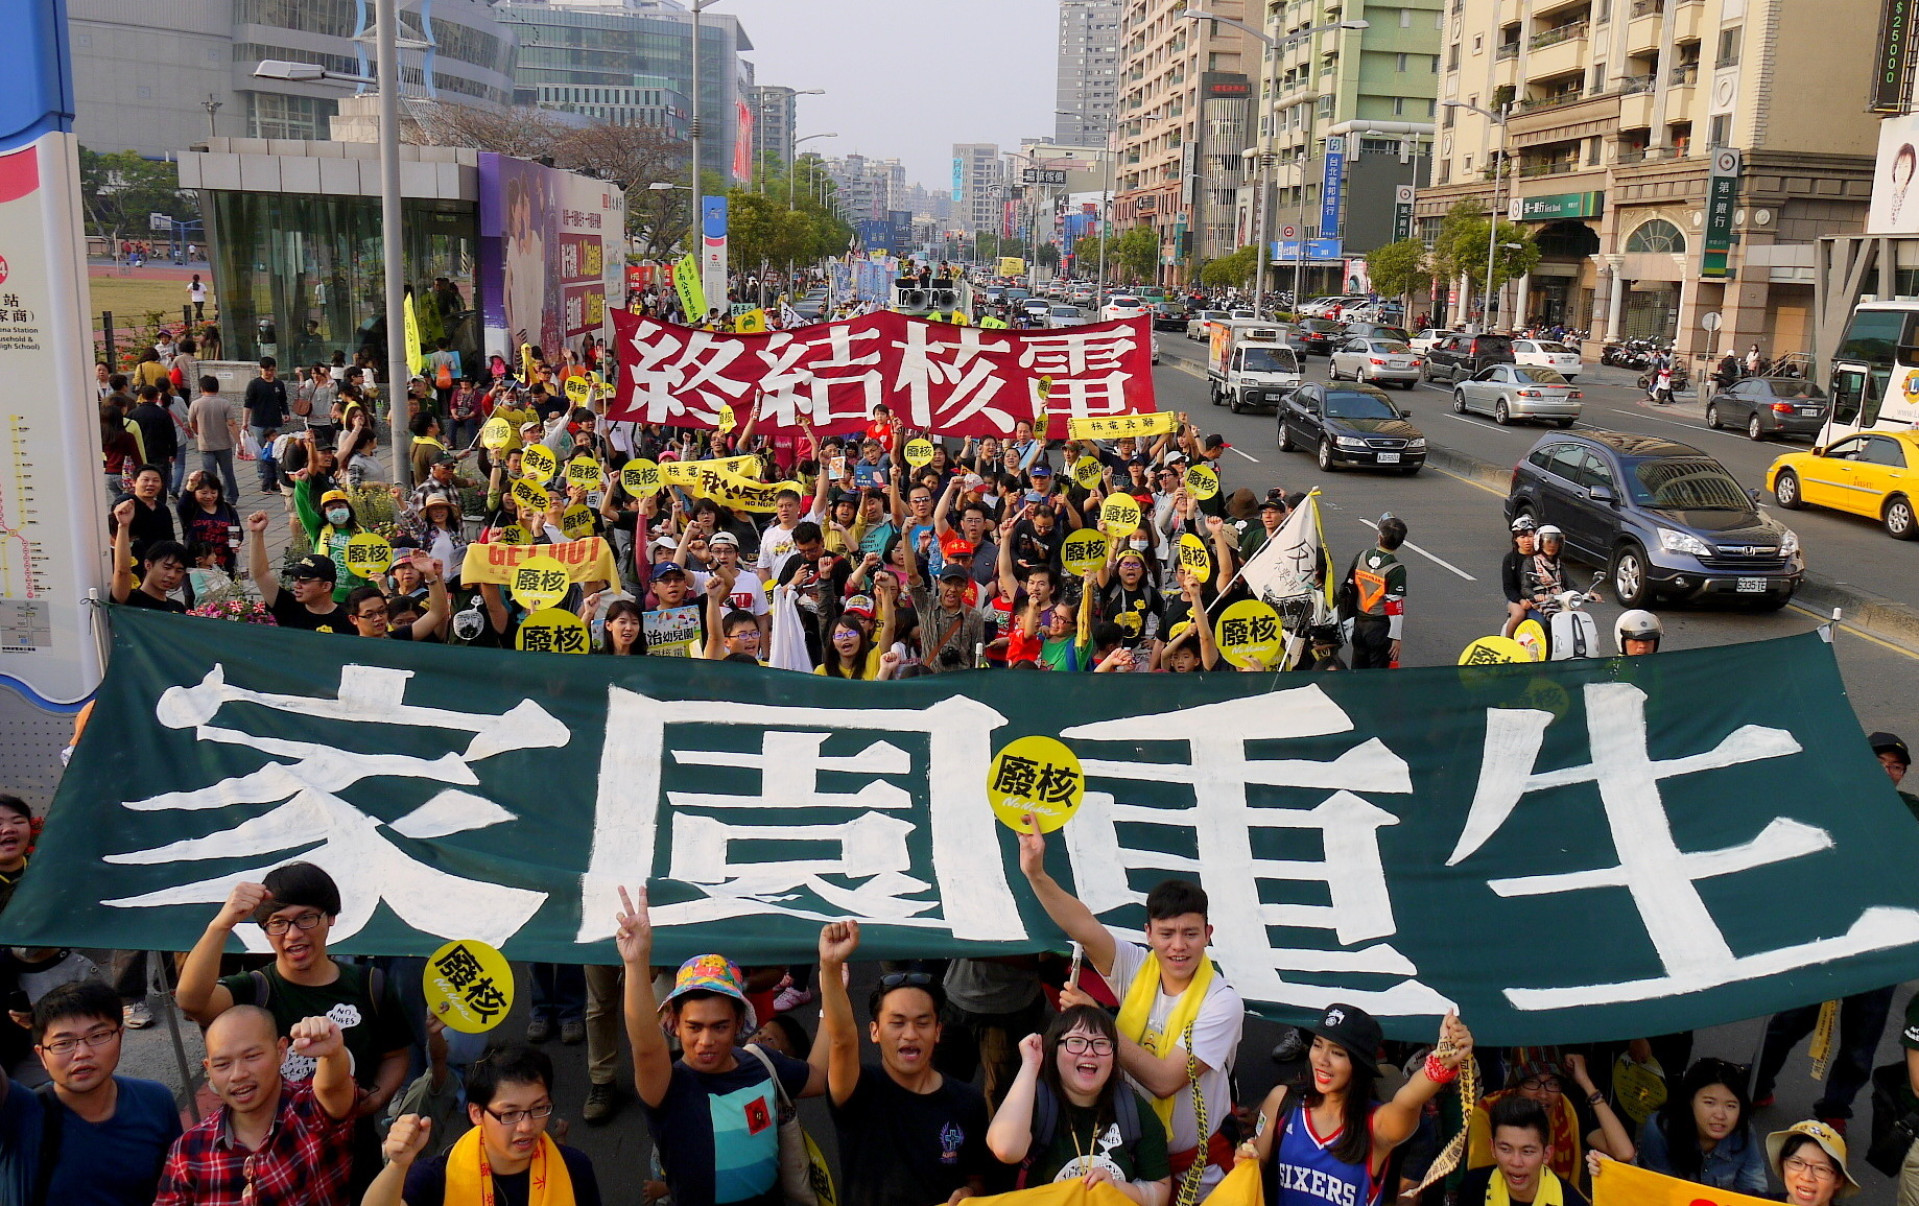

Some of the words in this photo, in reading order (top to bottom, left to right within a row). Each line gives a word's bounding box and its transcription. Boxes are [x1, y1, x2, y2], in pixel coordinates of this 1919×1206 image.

[1885, 2, 1903, 83] $25000
[1326, 157, 1338, 216] 台北富邦銀行
[1524, 201, 1545, 214] 第一銀行
[1714, 182, 1729, 227] 第一銀行
[3, 293, 19, 307] 站
[14, 343, 40, 351] School)
[625, 319, 1140, 433] 終結核電
[485, 426, 509, 440] 廢核
[523, 449, 555, 475] 廢核
[906, 445, 933, 458] 廢核
[569, 464, 599, 480] 廢核
[624, 467, 660, 486] 廢核
[1078, 461, 1101, 481] 廢核
[1186, 469, 1217, 492] 廢核
[513, 481, 549, 512] 廢核
[563, 509, 591, 531] 廢核
[1104, 504, 1139, 525] 廢核
[348, 543, 389, 563] 廢核
[1065, 540, 1106, 562] 廢核
[1181, 545, 1208, 568] 廢核
[514, 568, 566, 592] 廢核
[522, 624, 585, 652] 廢核
[1221, 614, 1278, 647] 廢核
[992, 754, 1078, 808] 廢核
[1001, 796, 1022, 810] No
[1021, 799, 1064, 819] Nuke
[100, 663, 1919, 1017] 家園重生
[434, 943, 502, 1025] 廢核
[329, 1013, 355, 1025] NUKES
[337, 1008, 352, 1016] NO
[1279, 1162, 1357, 1206] SIXERS
